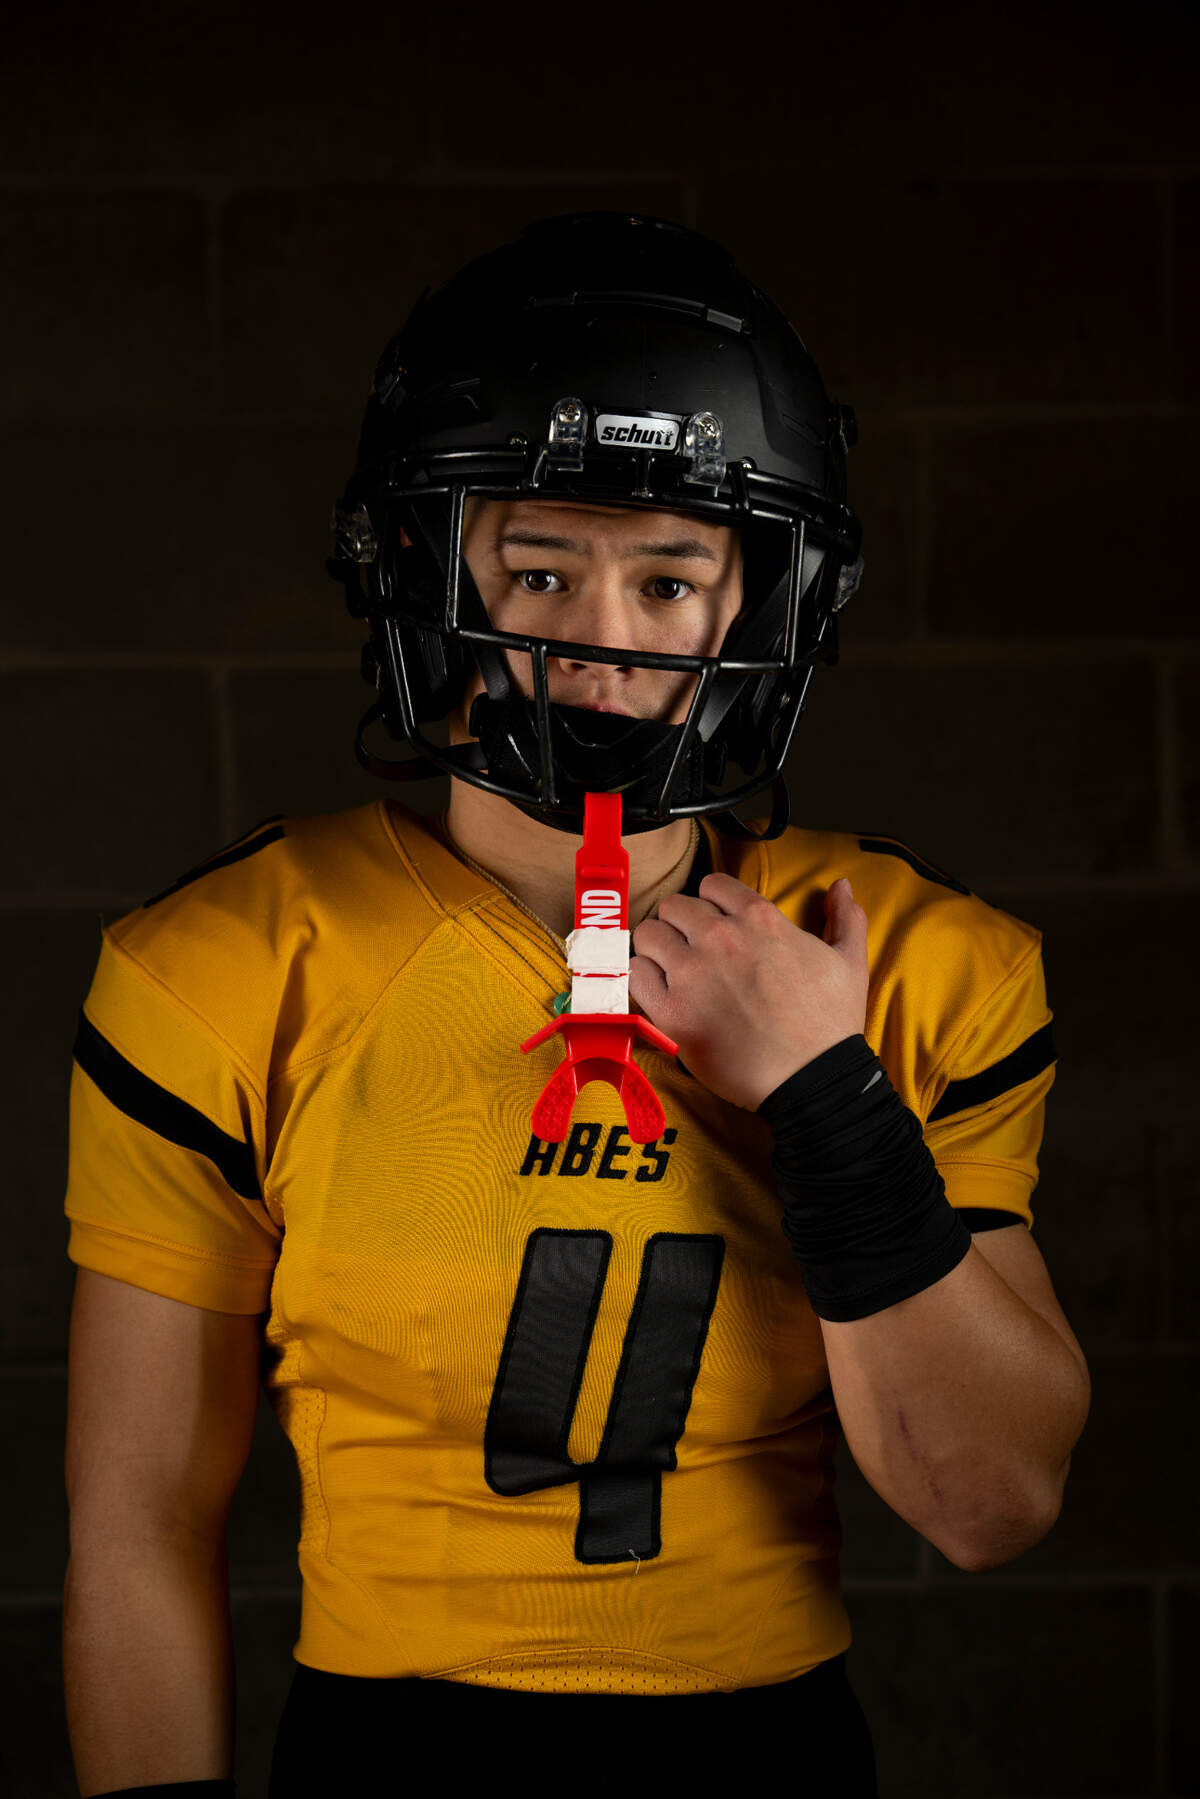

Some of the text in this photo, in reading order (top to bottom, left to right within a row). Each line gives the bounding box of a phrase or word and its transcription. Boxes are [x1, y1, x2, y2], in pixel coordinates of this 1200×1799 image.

[601, 423, 674, 446] schutt
[580, 889, 622, 929] ND
[483, 1227, 726, 1565] 4
